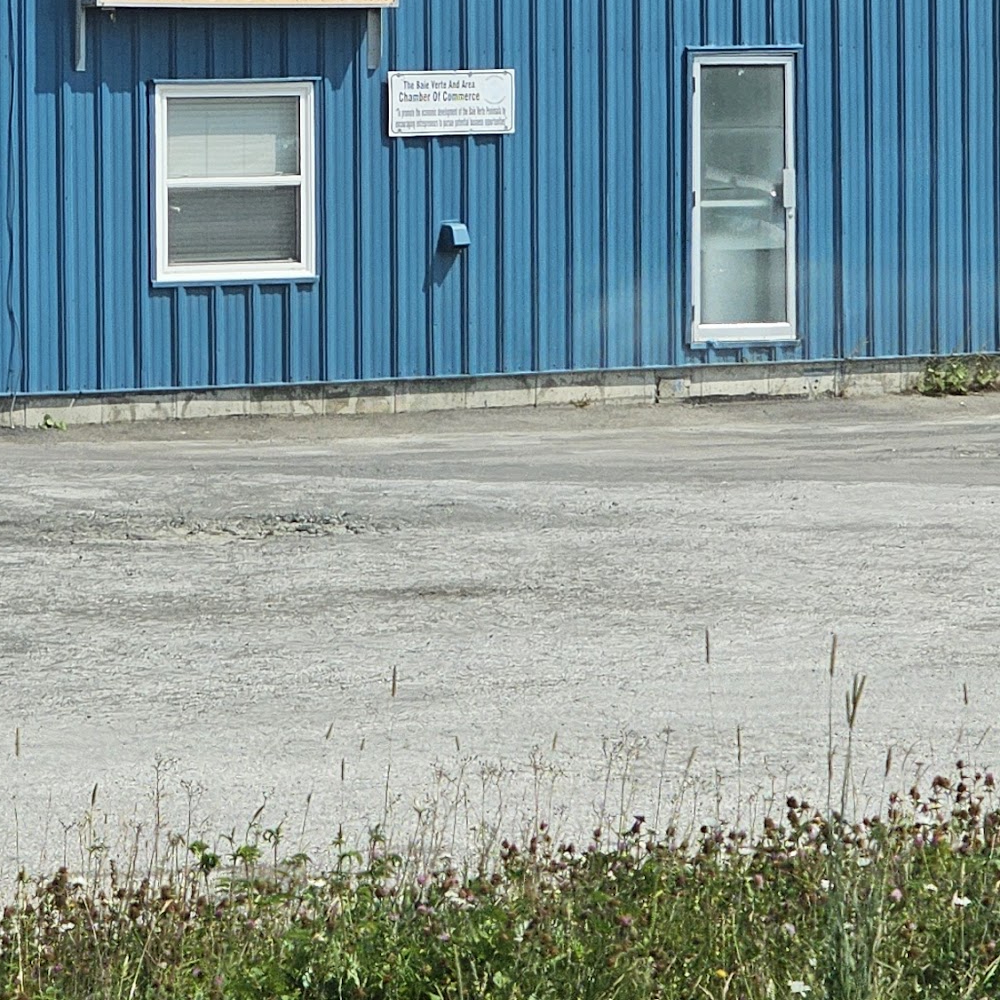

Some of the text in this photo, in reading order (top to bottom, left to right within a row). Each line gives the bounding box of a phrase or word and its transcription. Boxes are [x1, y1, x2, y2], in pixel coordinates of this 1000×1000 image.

[403, 80, 475, 89] The Baie Verte And Area
[399, 91, 480, 102] Chamber Of Commerce
